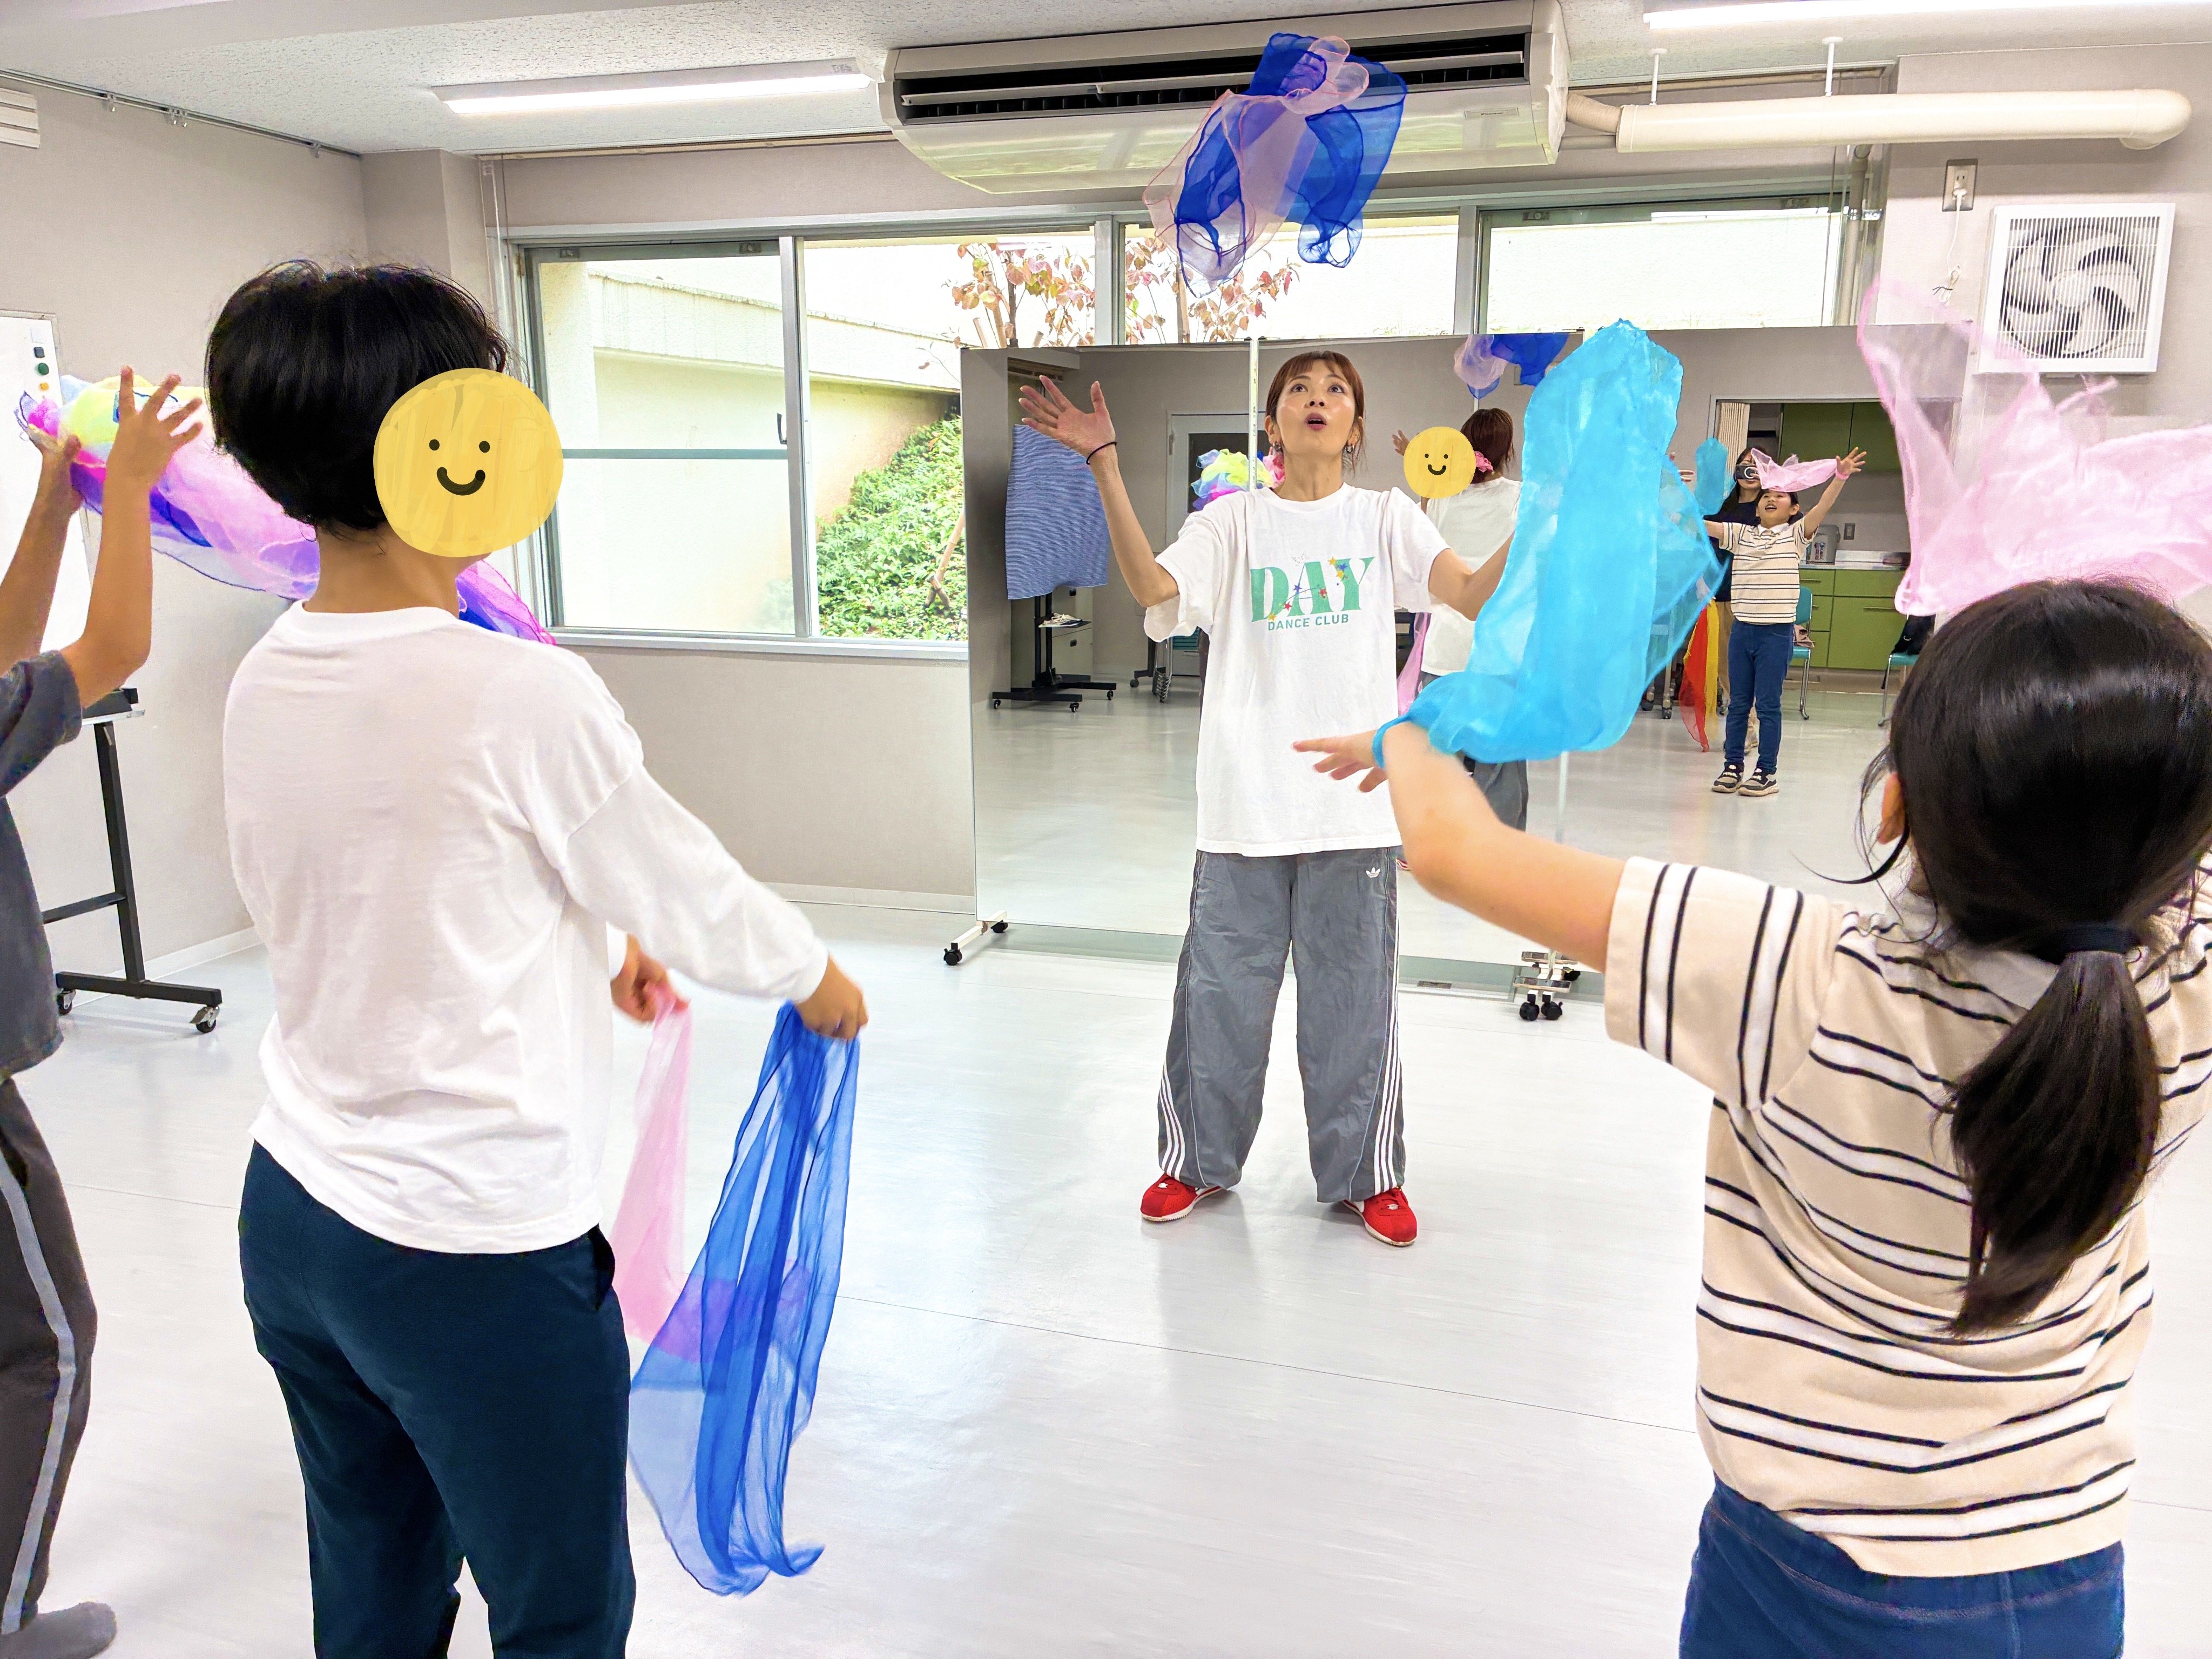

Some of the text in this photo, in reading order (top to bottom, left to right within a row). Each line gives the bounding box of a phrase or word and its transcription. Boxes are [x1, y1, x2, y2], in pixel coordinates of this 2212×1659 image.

[1249, 556, 1375, 622] DAY
[1268, 613, 1348, 631] DANCE CLUB
